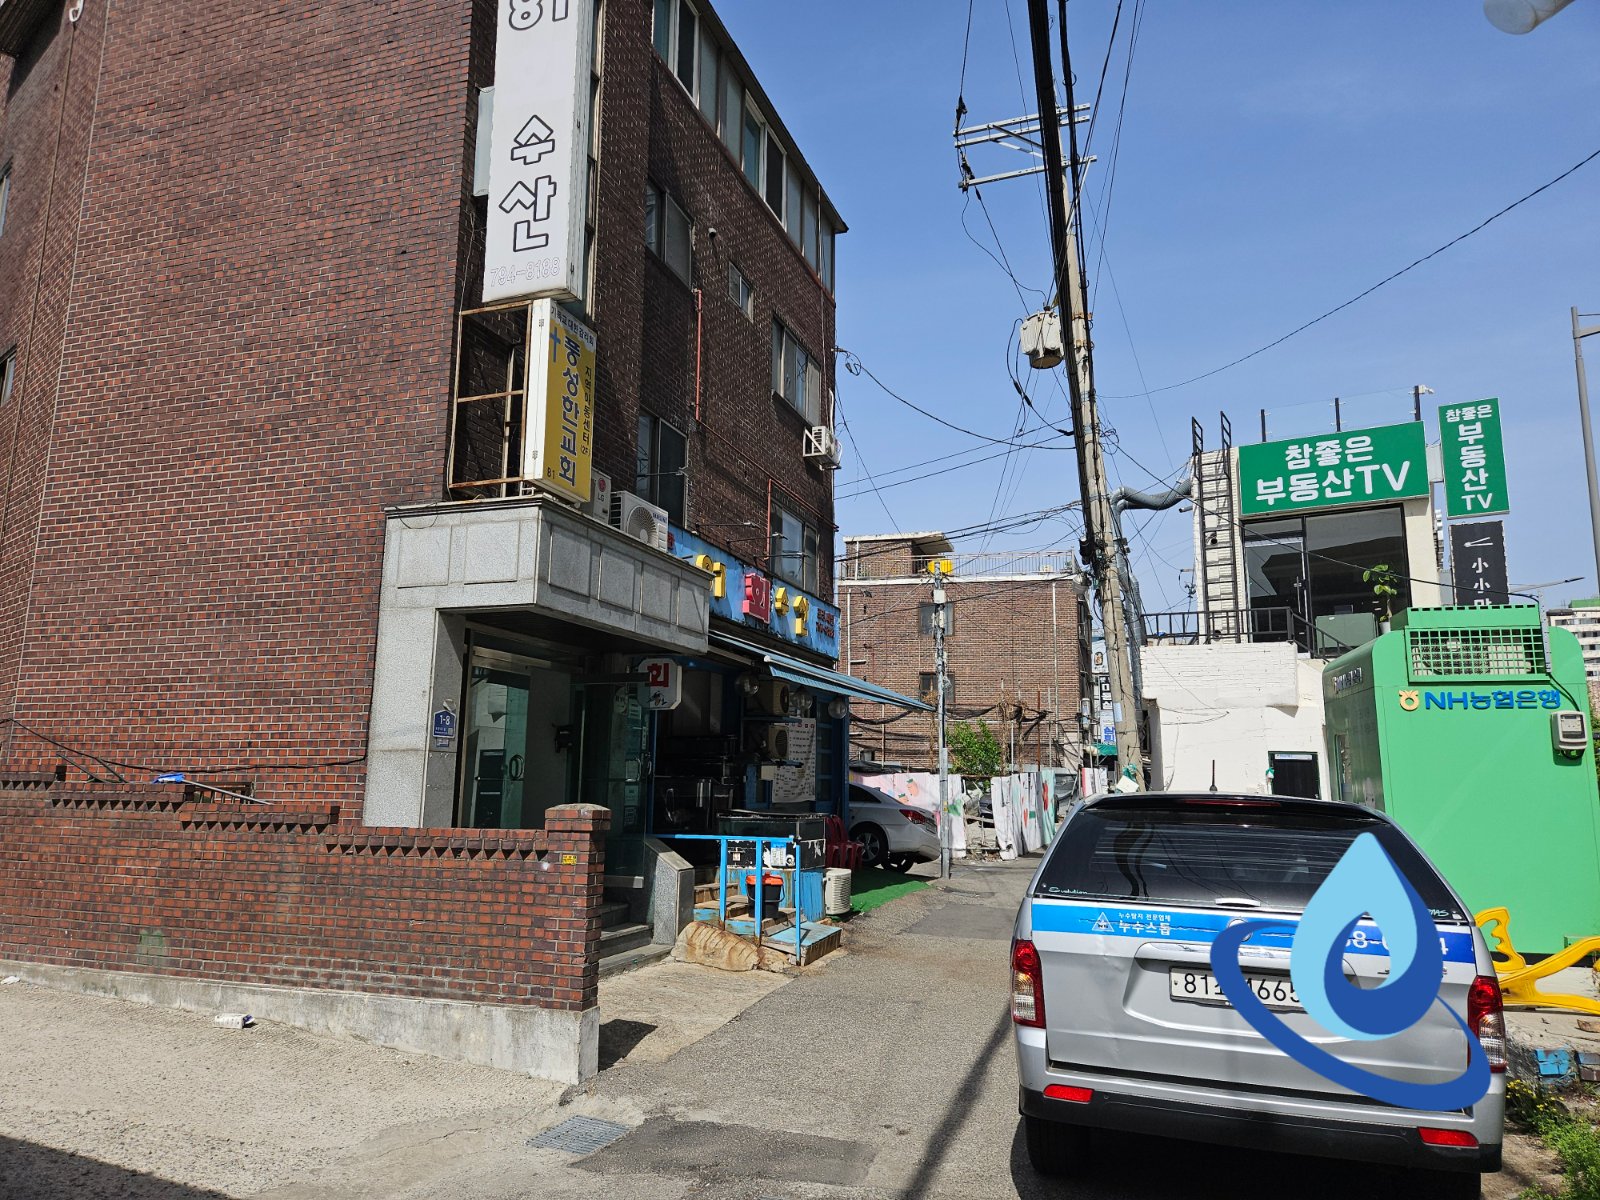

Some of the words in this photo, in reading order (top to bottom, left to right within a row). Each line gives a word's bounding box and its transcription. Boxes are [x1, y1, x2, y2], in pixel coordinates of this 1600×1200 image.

[498, 114, 557, 253] 수산
[559, 335, 581, 487] 풍성한교회
[1446, 404, 1493, 423] 참좋은
[1284, 435, 1374, 470] 참좋은
[1457, 421, 1489, 492] 부동산
[1255, 460, 1411, 506] 부동산TV
[1461, 492, 1493, 511] TV
[1425, 689, 1562, 711] NH농협은행
[439, 714, 451, 726] 1-8
